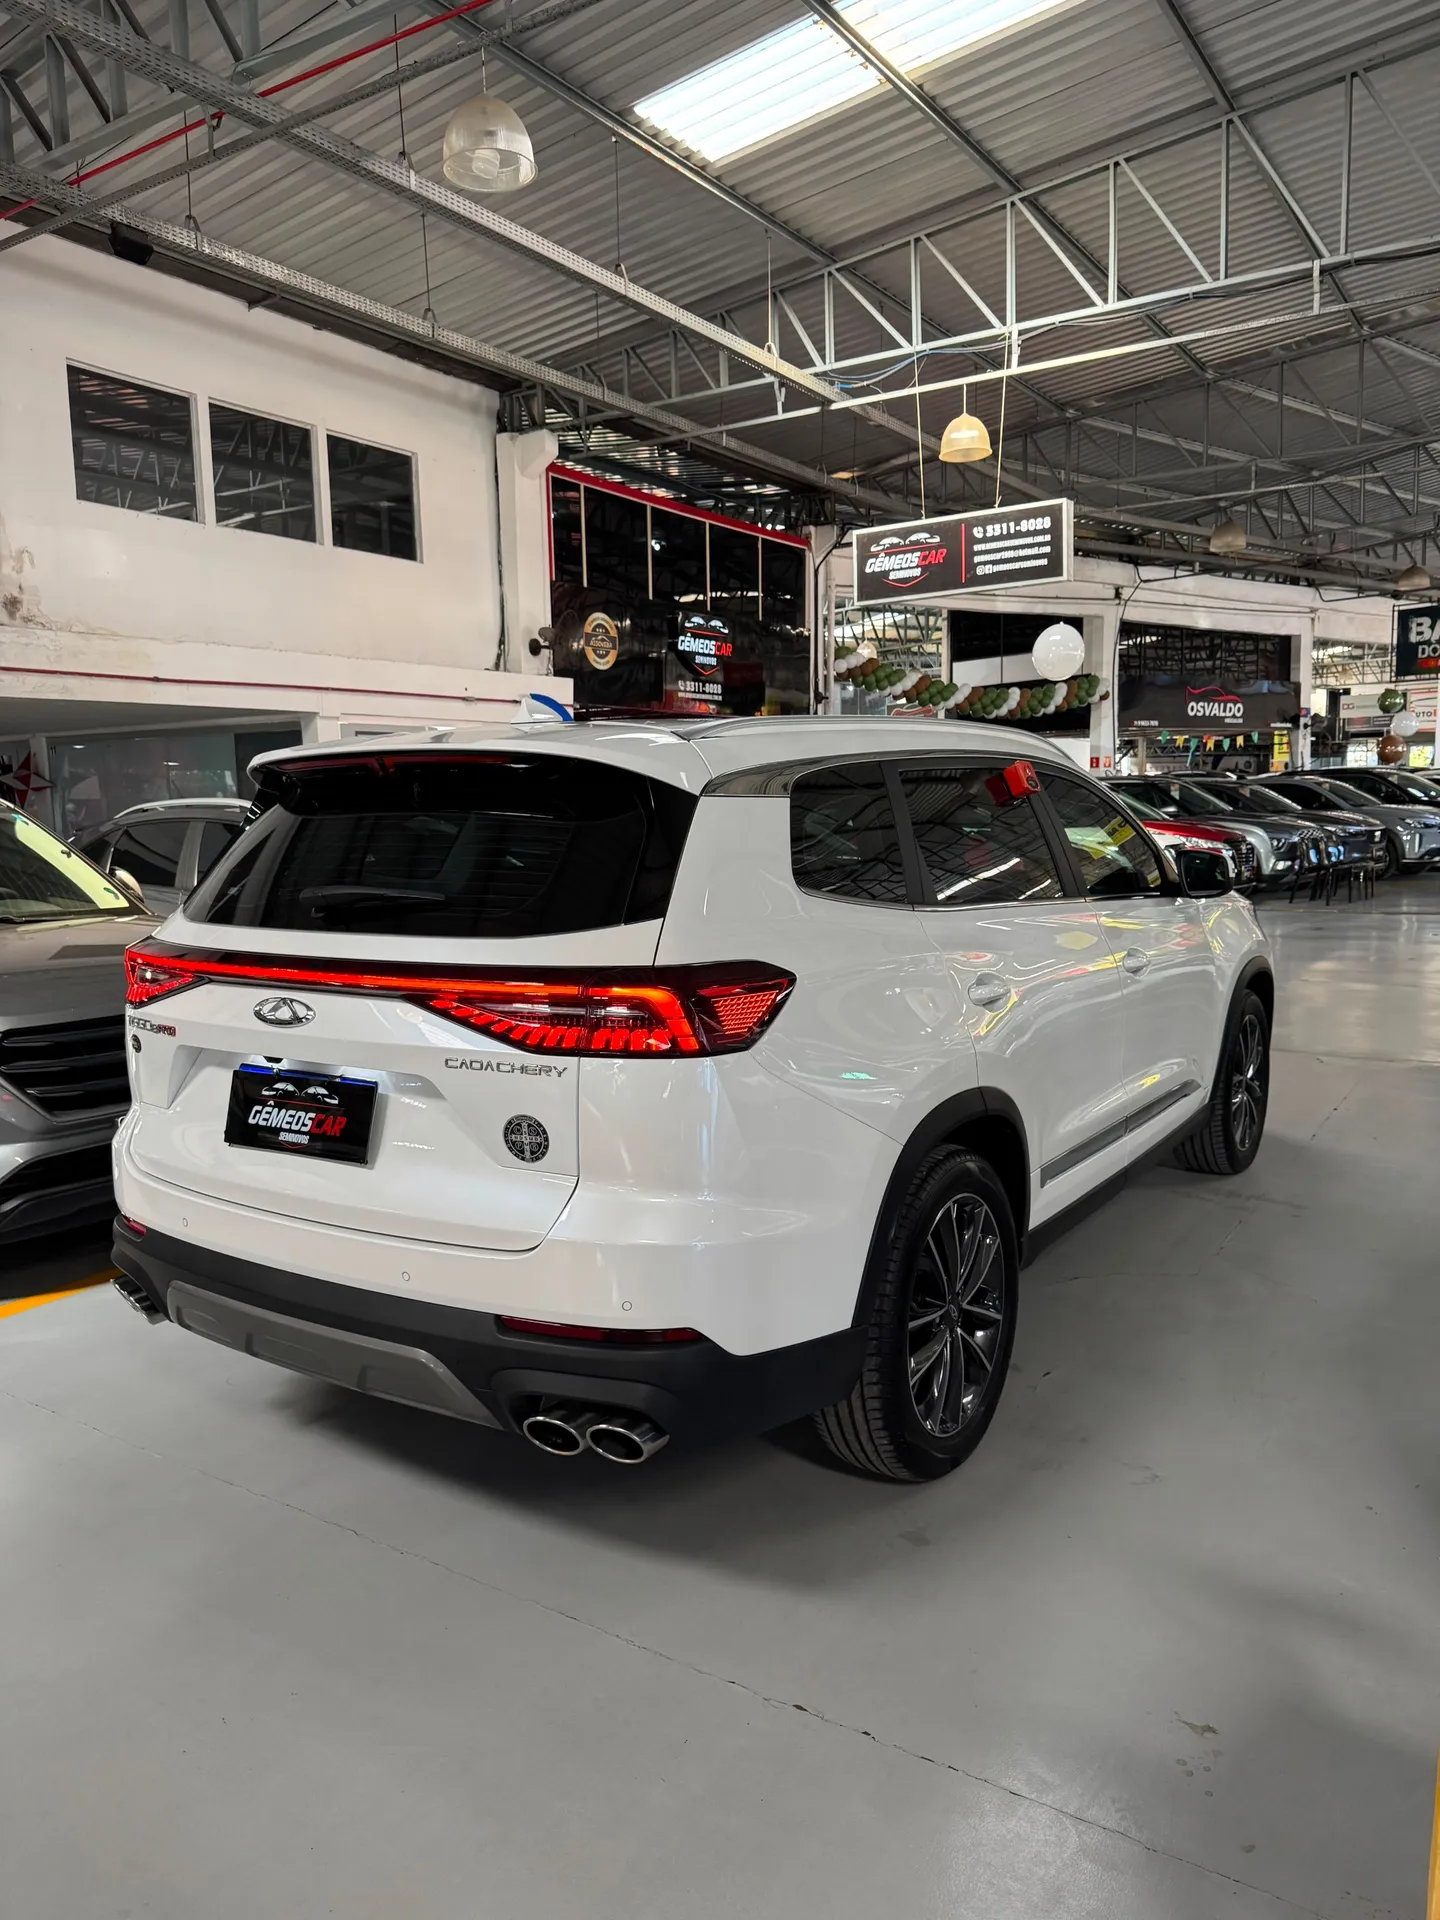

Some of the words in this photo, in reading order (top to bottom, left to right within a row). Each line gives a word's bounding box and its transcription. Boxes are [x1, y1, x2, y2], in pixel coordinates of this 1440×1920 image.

[985, 516, 1051, 537] 3311-8028
[686, 681, 722, 695] 3311-8028
[1187, 701, 1243, 717] OSVALDO
